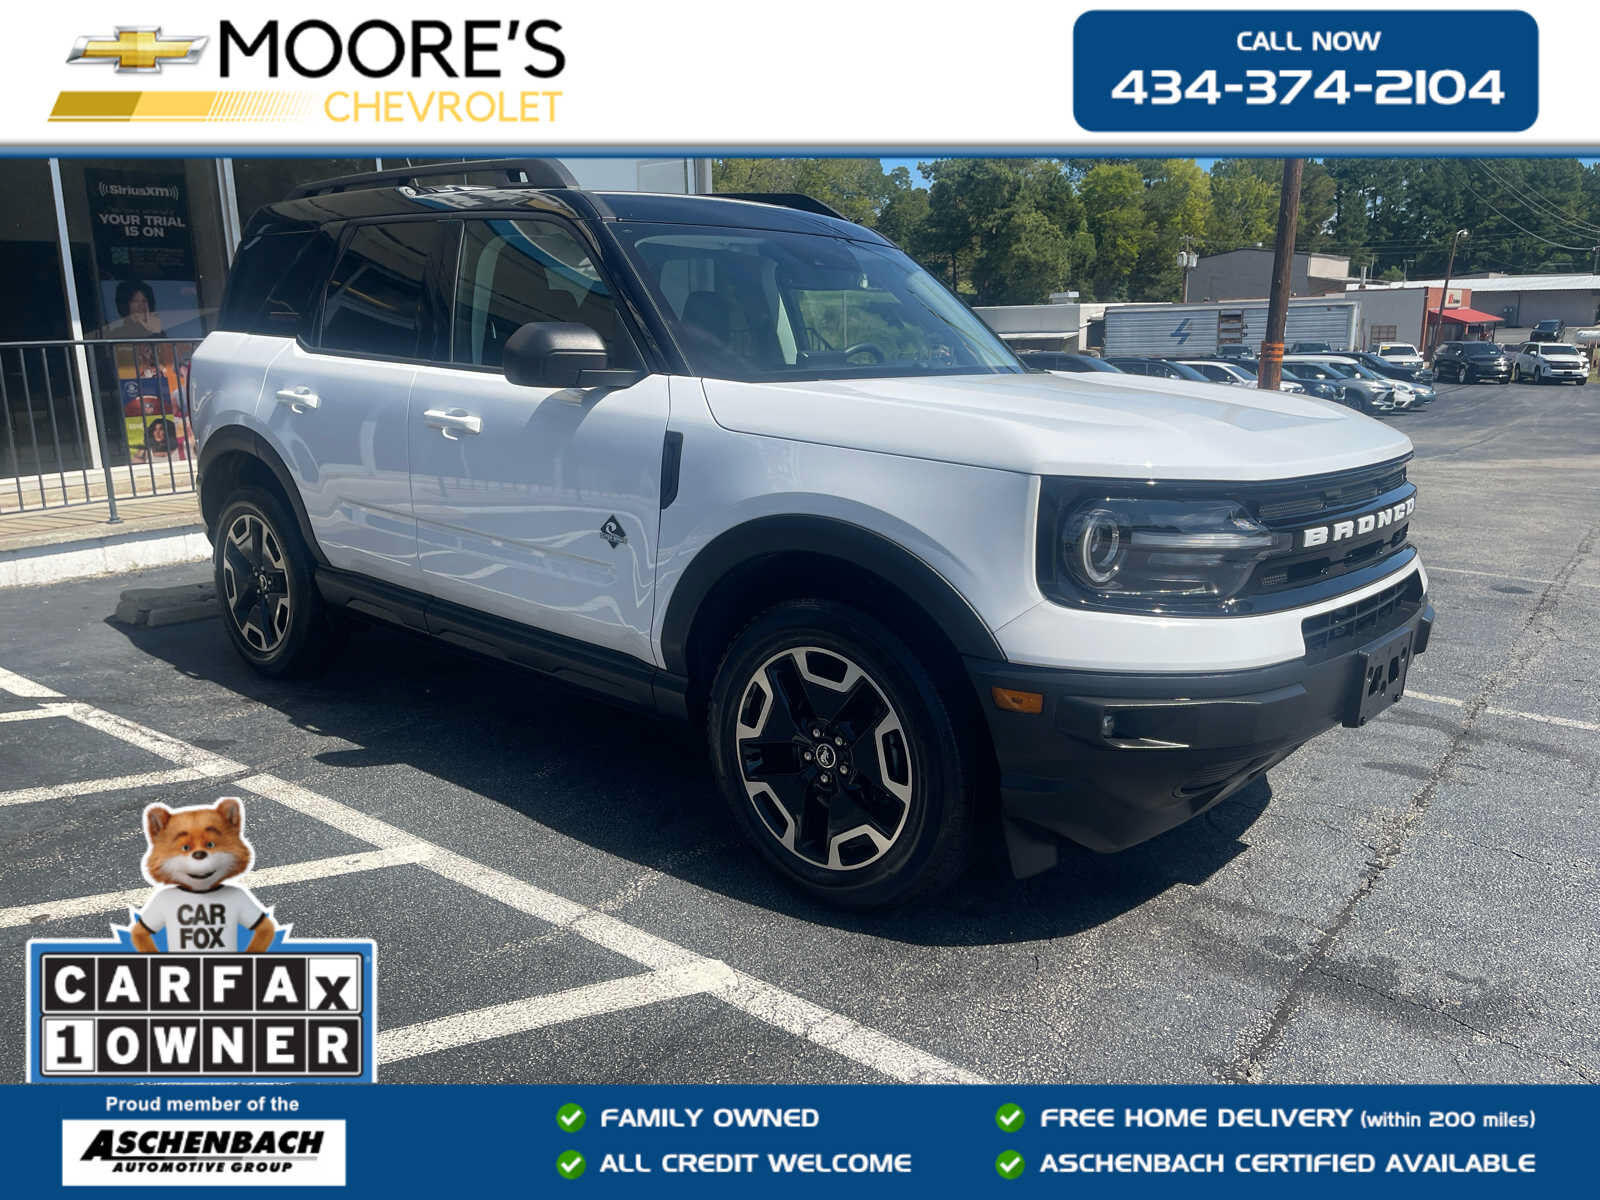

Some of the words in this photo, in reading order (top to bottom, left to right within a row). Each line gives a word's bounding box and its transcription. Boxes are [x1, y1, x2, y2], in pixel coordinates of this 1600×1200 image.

[99, 213, 140, 226] YOUR
[144, 215, 186, 228] TRIAL
[125, 226, 139, 237] IS
[142, 227, 165, 238] ON
[1303, 497, 1416, 548] BRONCO
